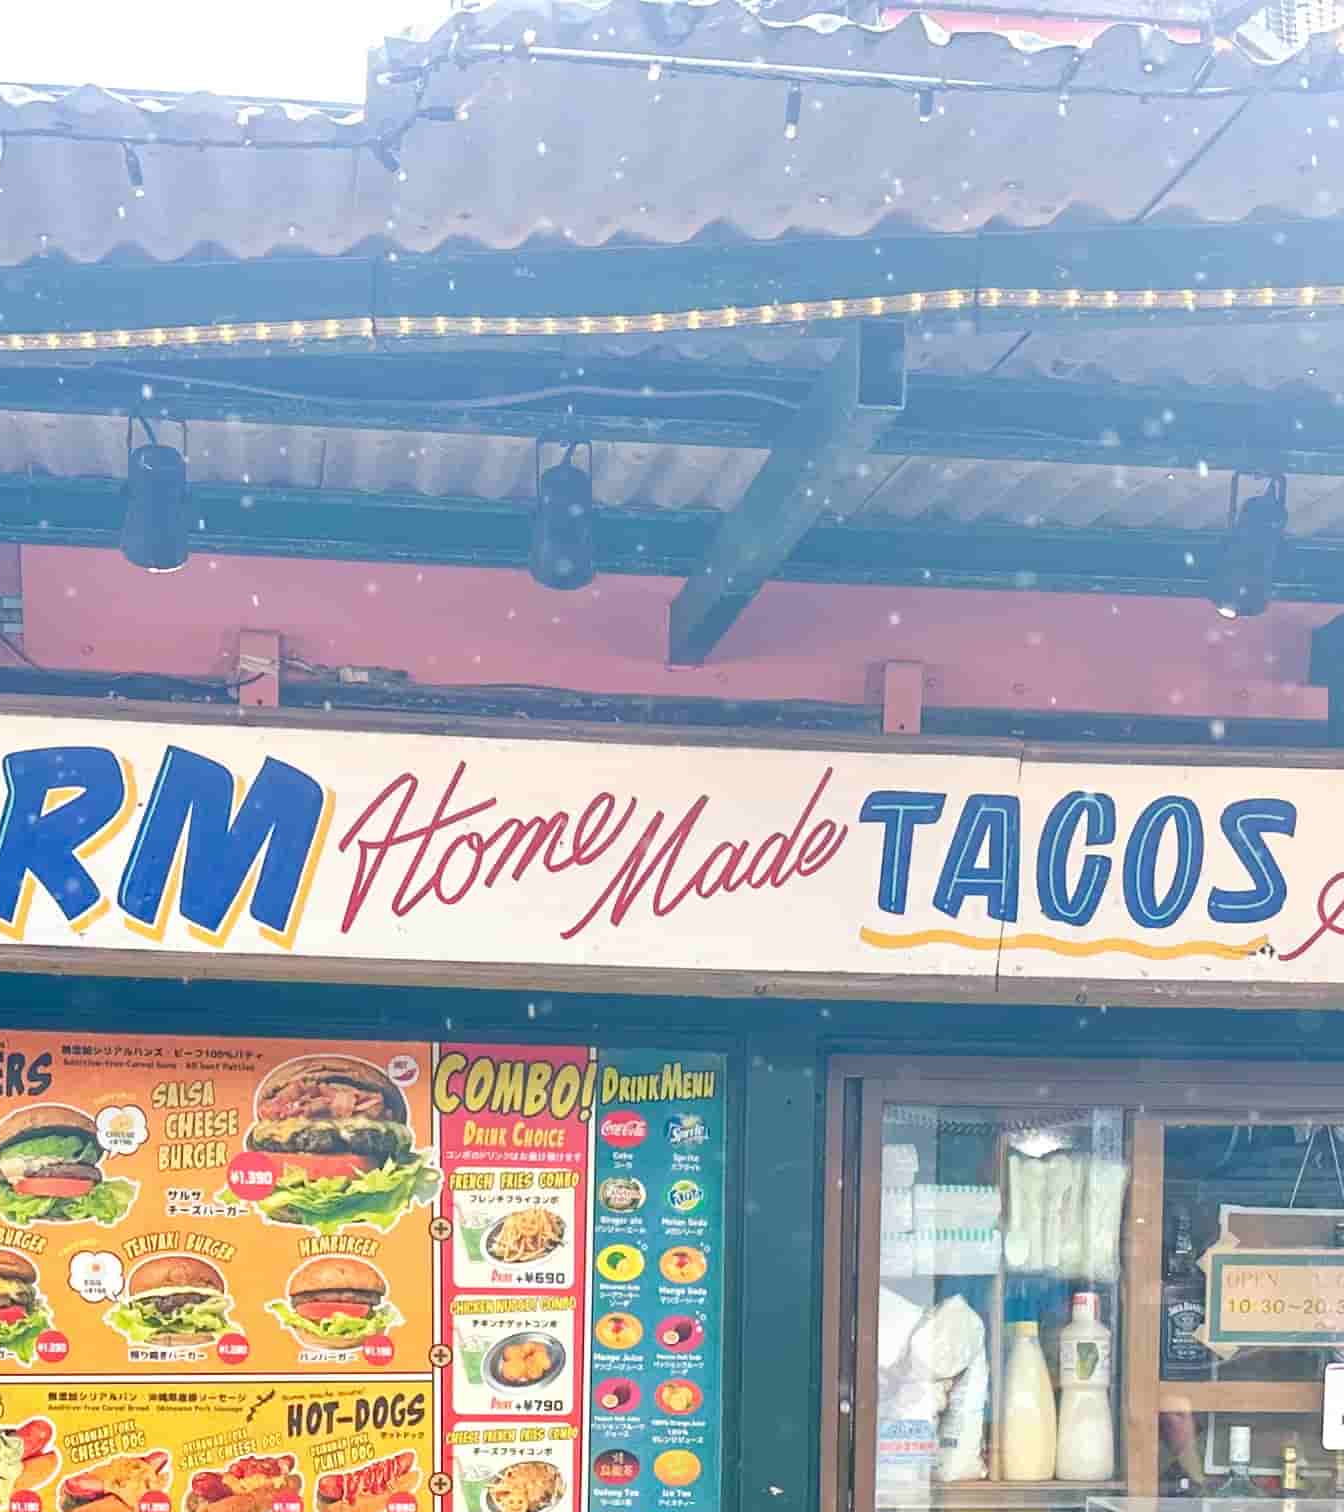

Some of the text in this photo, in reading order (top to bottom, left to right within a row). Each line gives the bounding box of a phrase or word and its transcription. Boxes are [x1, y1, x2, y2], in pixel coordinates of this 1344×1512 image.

[339, 761, 1298, 940] Home Made TACOS
[151, 1080, 215, 1109] SALSA
[433, 1051, 599, 1122] COMBO!
[602, 1062, 715, 1105] DRINK MENU
[164, 1109, 239, 1140] CHEESE
[463, 1119, 566, 1148] DRINK CHOICE
[158, 1140, 229, 1172] BURGER
[123, 1231, 237, 1262] TERIYAKI BURGER
[297, 1234, 380, 1258] HAMBURGER
[287, 1393, 426, 1438] HOT-DOGS
[70, 1431, 145, 1464] CHEESE DOG
[312, 1442, 375, 1474] PLAIN DOG
